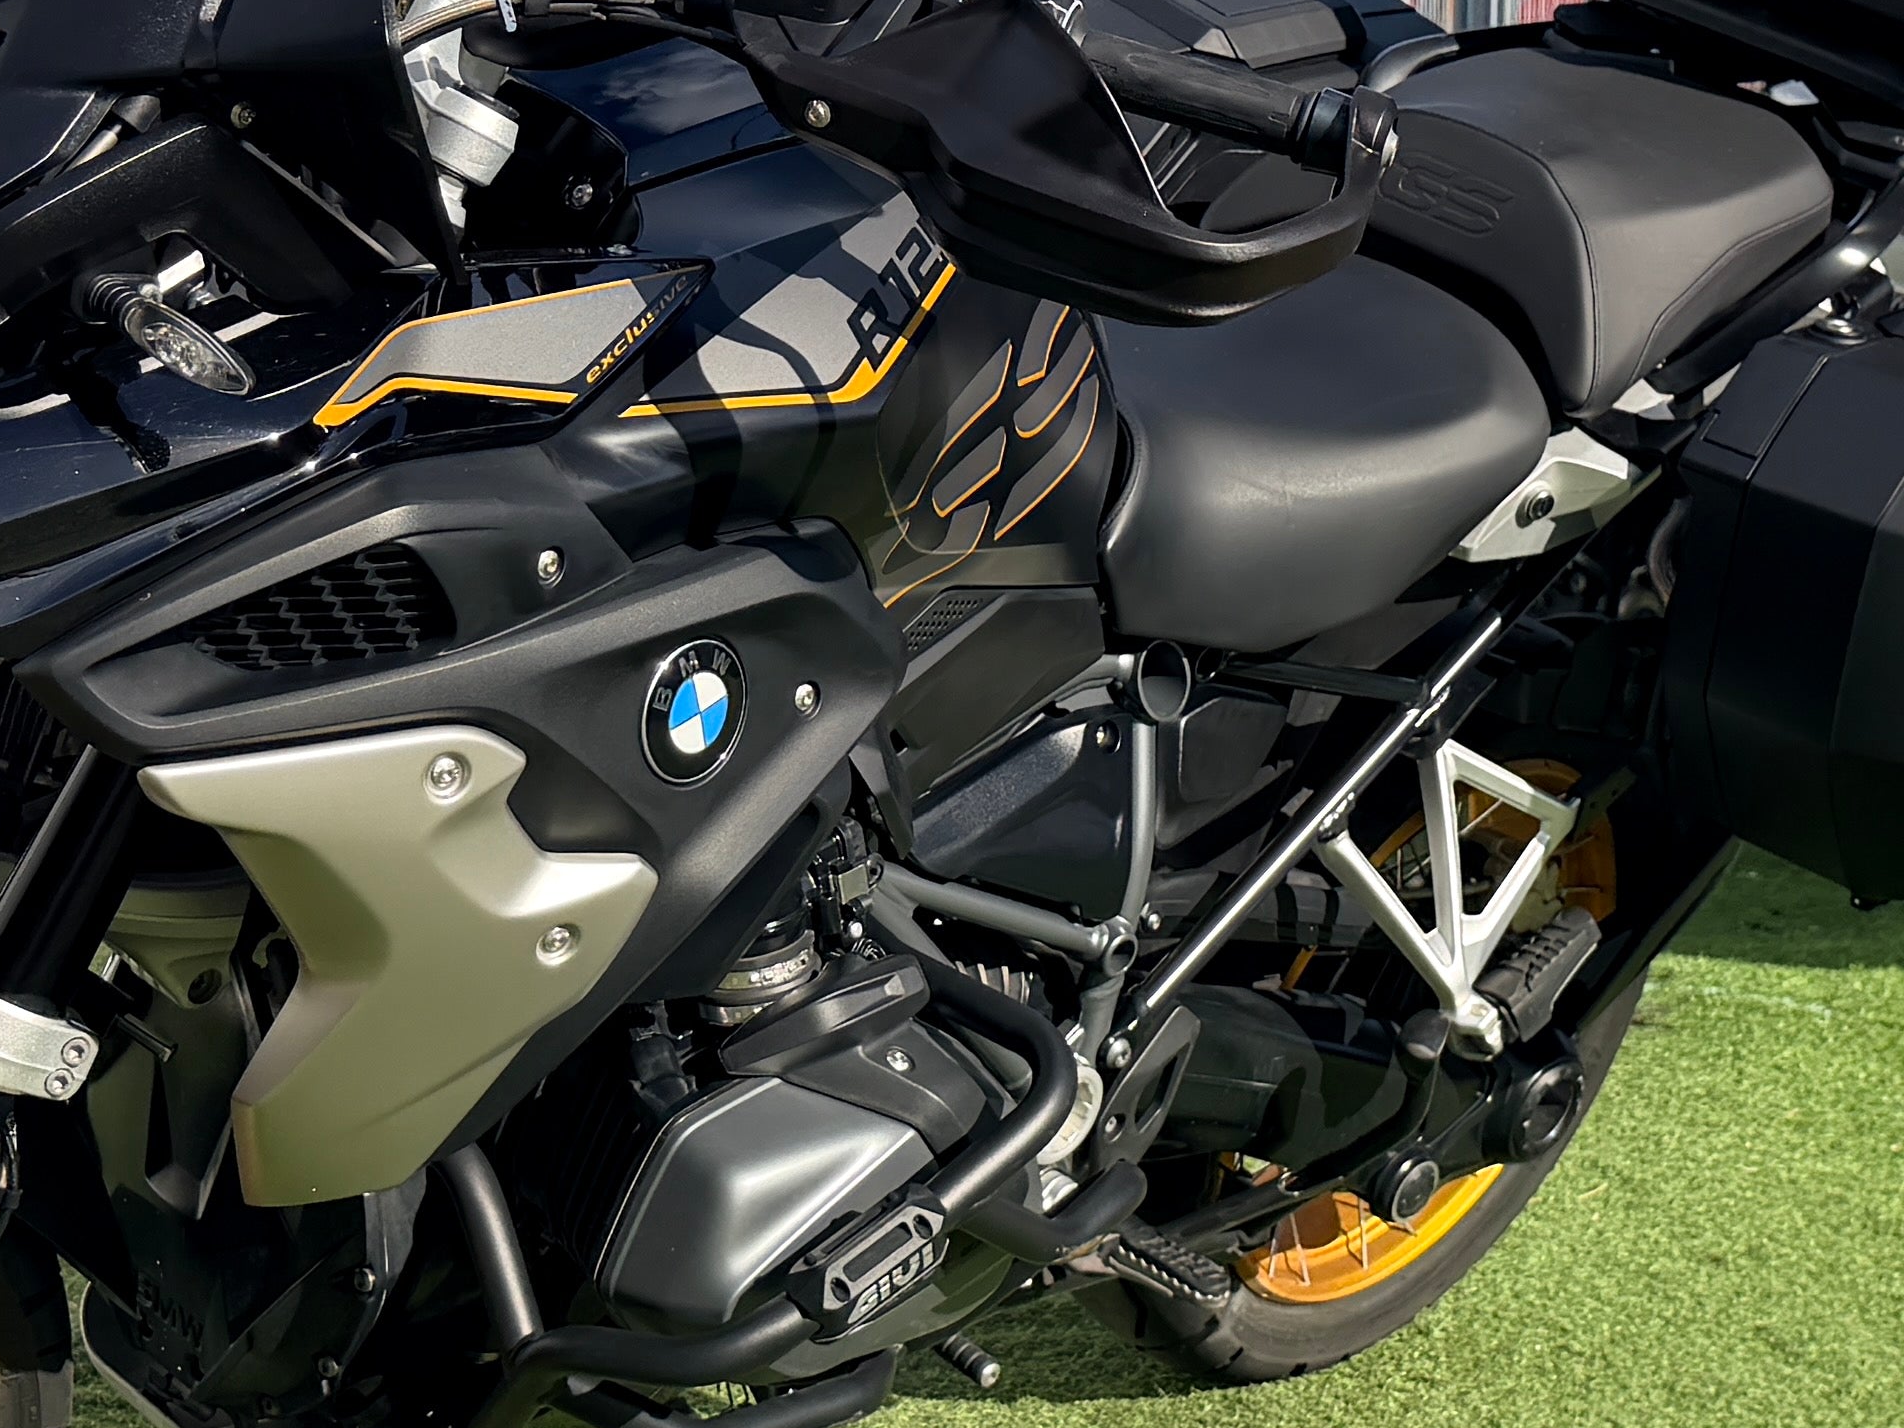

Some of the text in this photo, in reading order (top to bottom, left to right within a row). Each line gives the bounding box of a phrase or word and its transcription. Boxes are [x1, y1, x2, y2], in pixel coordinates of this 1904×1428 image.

[585, 274, 689, 385] exclusive
[652, 647, 733, 713] BMW
[846, 1241, 934, 1325] GIVI
